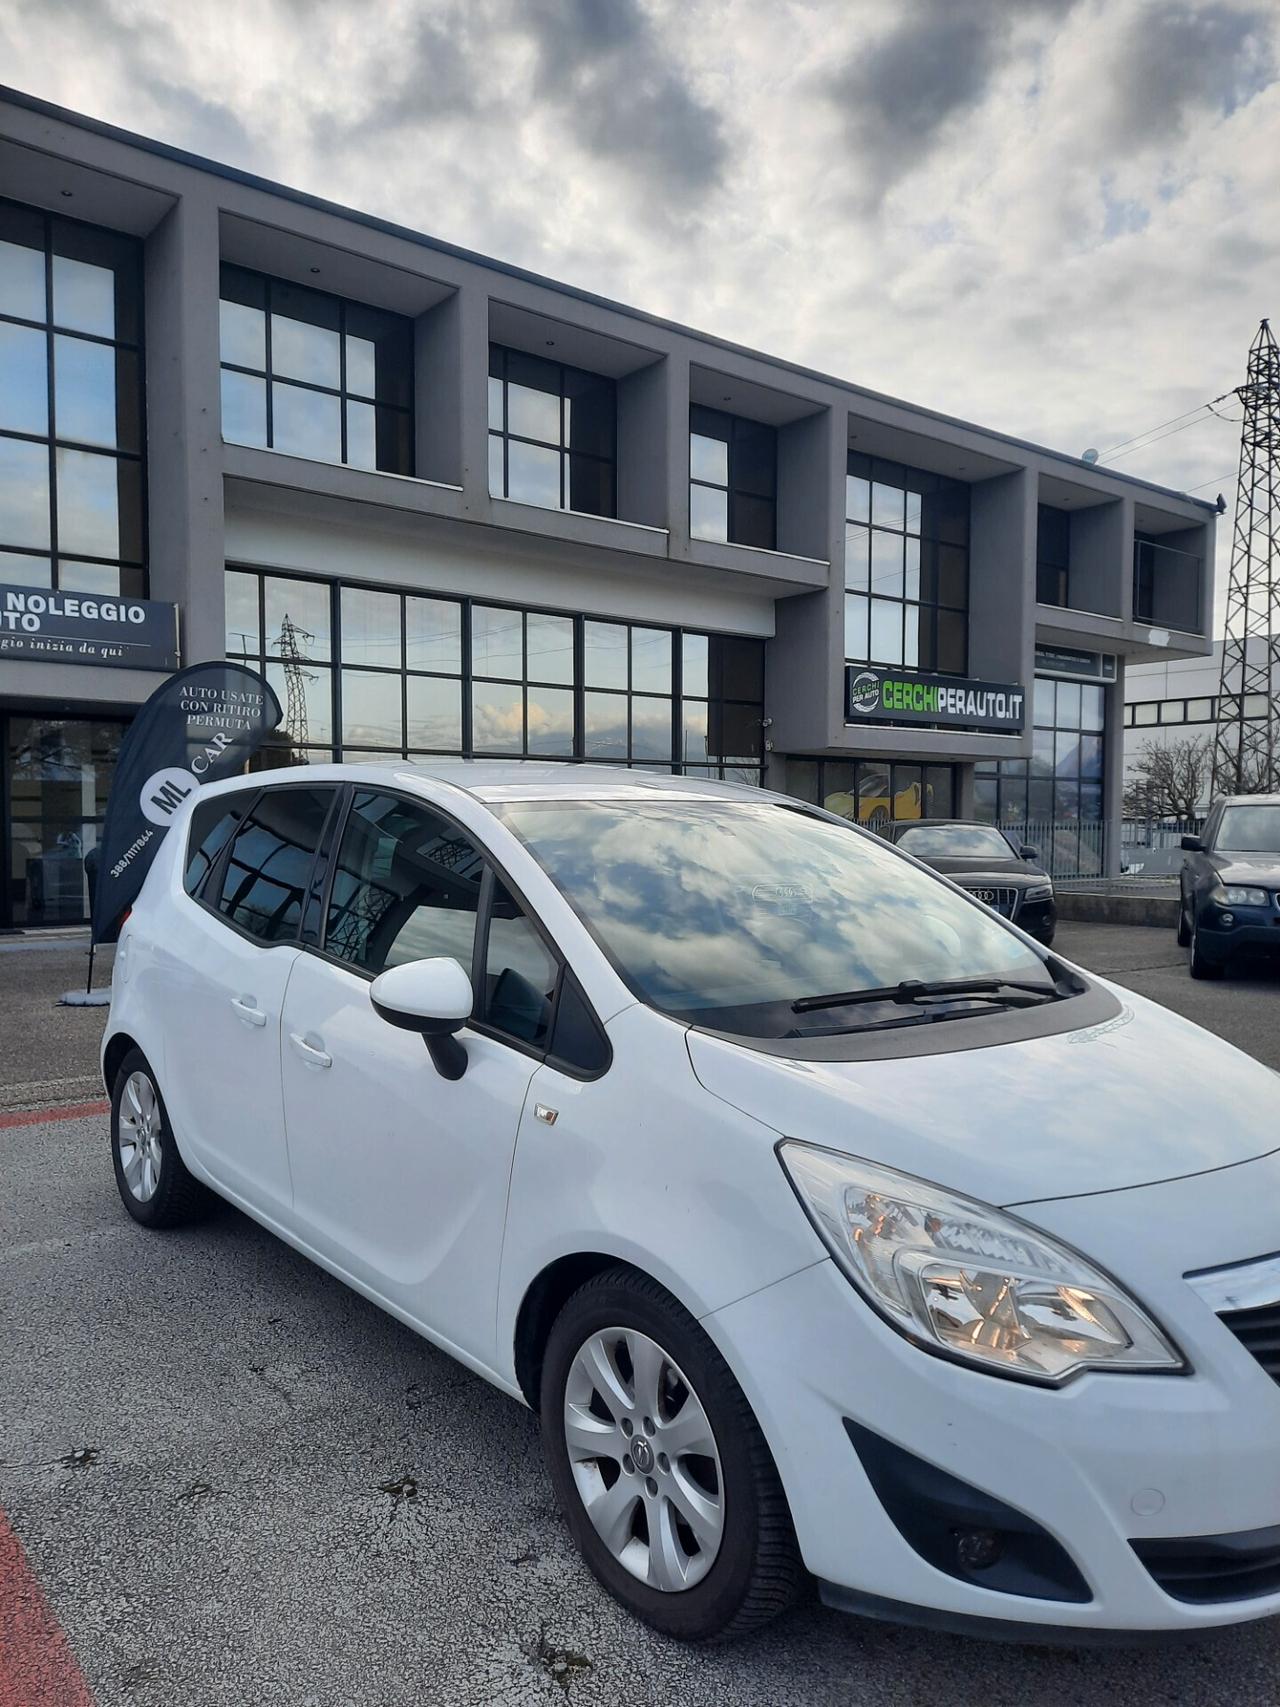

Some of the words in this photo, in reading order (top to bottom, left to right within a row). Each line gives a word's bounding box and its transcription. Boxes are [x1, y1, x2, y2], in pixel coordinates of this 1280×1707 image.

[7, 592, 146, 624] NOLEGGIO
[0, 611, 41, 632] TO
[30, 638, 73, 653] inizia
[79, 642, 96, 654] da
[101, 645, 123, 659] qui
[179, 686, 218, 699] AUTO
[221, 690, 264, 706] USATE
[852, 681, 880, 696] CERCHI
[852, 694, 864, 704] PER
[864, 689, 880, 699] AUTO
[180, 700, 209, 712] CON
[213, 703, 261, 718] RITIRO
[186, 714, 252, 730] PERMUTA
[150, 780, 192, 815] ML
[191, 732, 234, 774] CAR
[110, 829, 154, 878] 388/1117864
